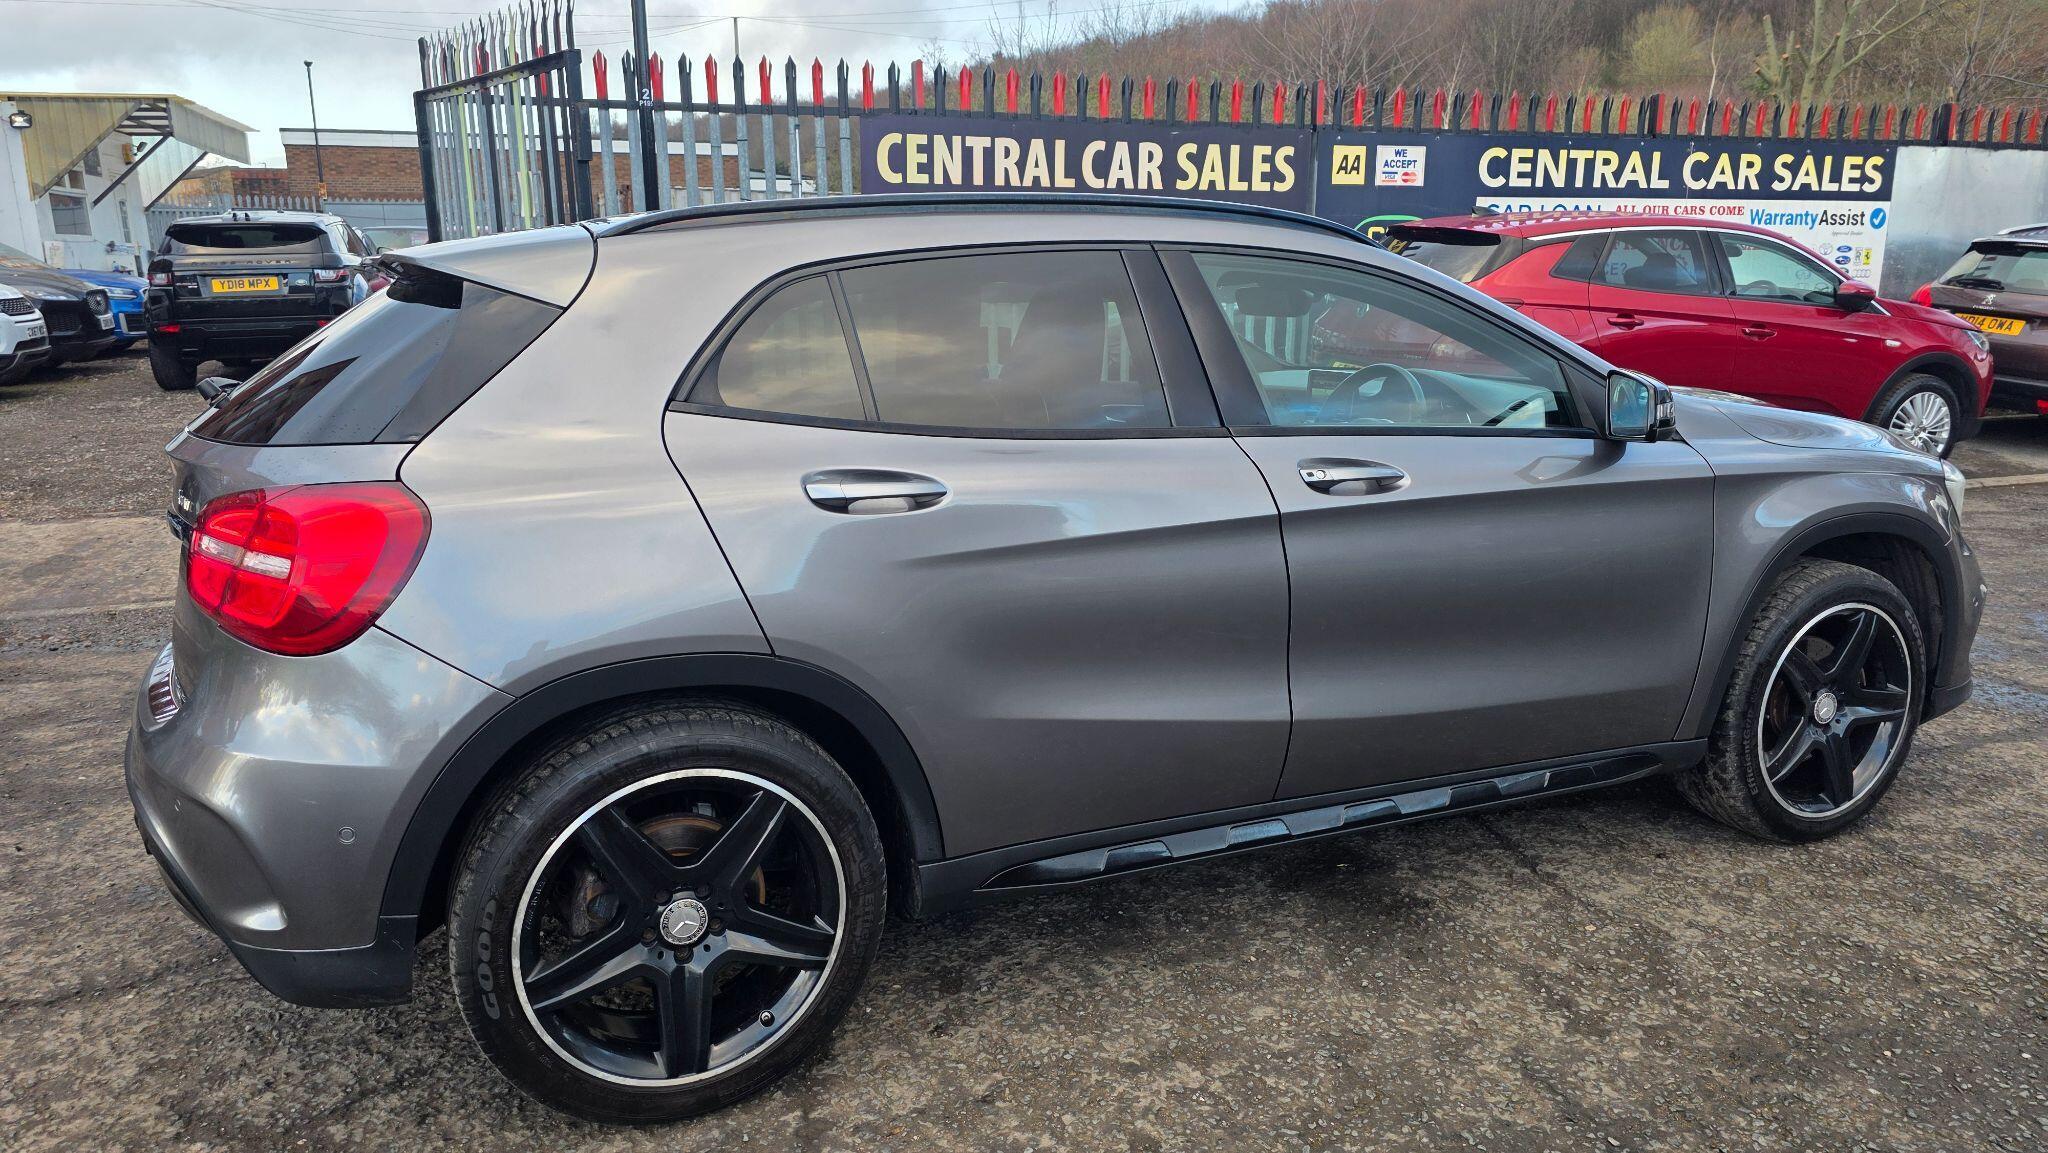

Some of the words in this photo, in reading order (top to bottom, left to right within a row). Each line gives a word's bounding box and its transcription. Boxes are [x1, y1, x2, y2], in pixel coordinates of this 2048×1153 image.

[641, 88, 650, 100] 2
[1394, 148, 1408, 158] WE
[876, 132, 1076, 188] CENTRAL
[1082, 140, 1164, 190] CAR
[1175, 142, 1296, 193] SALES
[1336, 154, 1361, 175] AA
[1383, 159, 1418, 169] ACCEPT
[1478, 146, 1670, 189] CENTRAL
[1682, 152, 1762, 192] CAR
[1771, 153, 1884, 193] SALES
[1615, 205, 1639, 214] ALL
[1642, 205, 1670, 216] OUR
[1673, 205, 1706, 216] CARS
[1709, 205, 1745, 216] COME
[219, 280, 245, 290] YD18
[247, 278, 271, 289] MPX
[1987, 318, 2014, 332] OWA
[477, 898, 501, 1020] GOOD
